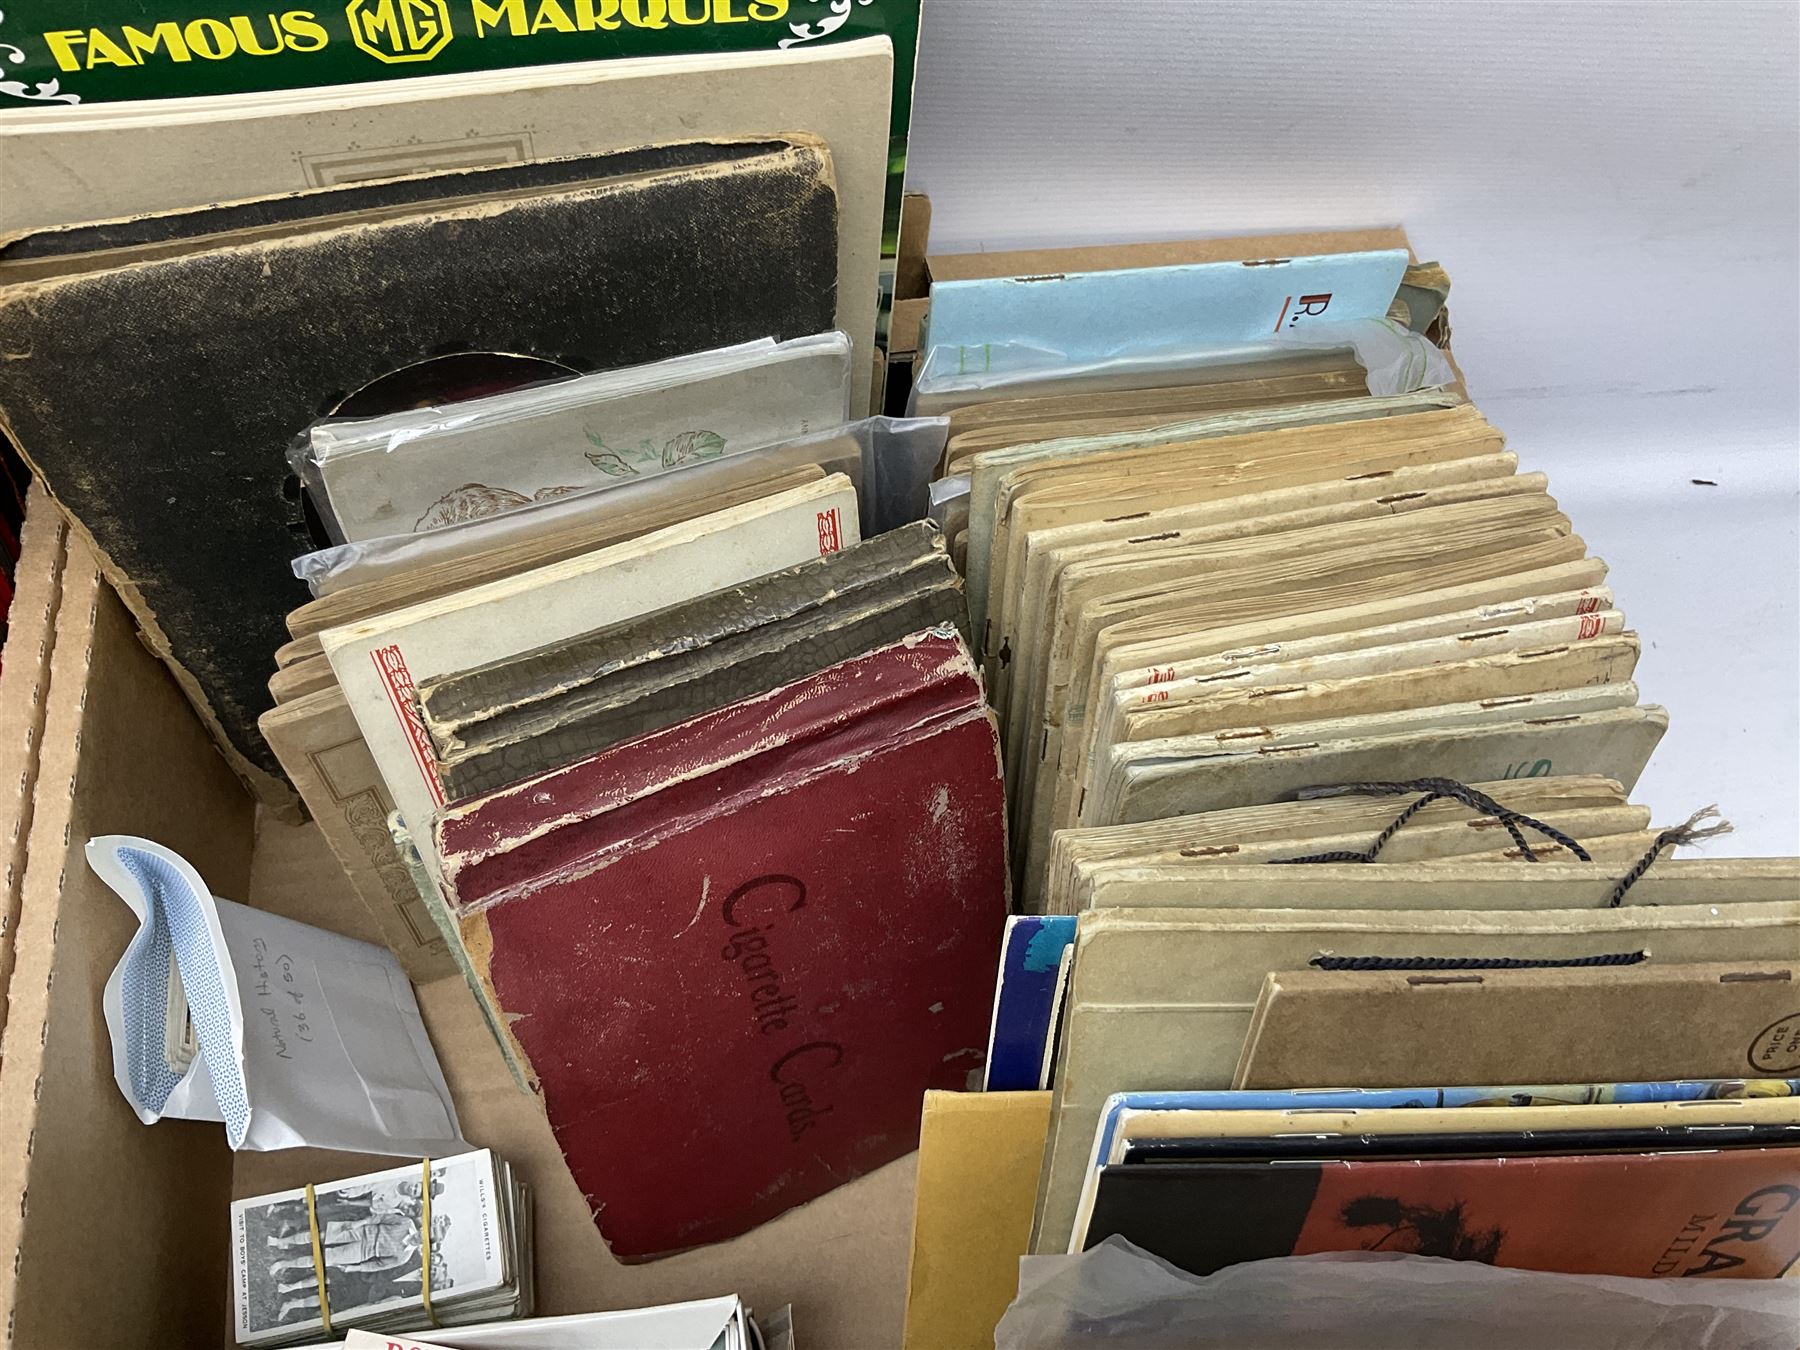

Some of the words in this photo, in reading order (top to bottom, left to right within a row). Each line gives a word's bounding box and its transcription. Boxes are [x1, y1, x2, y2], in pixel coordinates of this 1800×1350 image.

[43, 10, 330, 72] FAMOUS
[358, 0, 438, 52] MG
[721, 873, 807, 1036] Cigarette
[260, 1008, 293, 1059] Natural
[1762, 1026, 1789, 1060] PRICE
[240, 1234, 245, 1243] TO
[482, 1212, 491, 1260] CIGARETTES
[1652, 1213, 1717, 1275] MILD
[242, 1292, 248, 1300] AT
